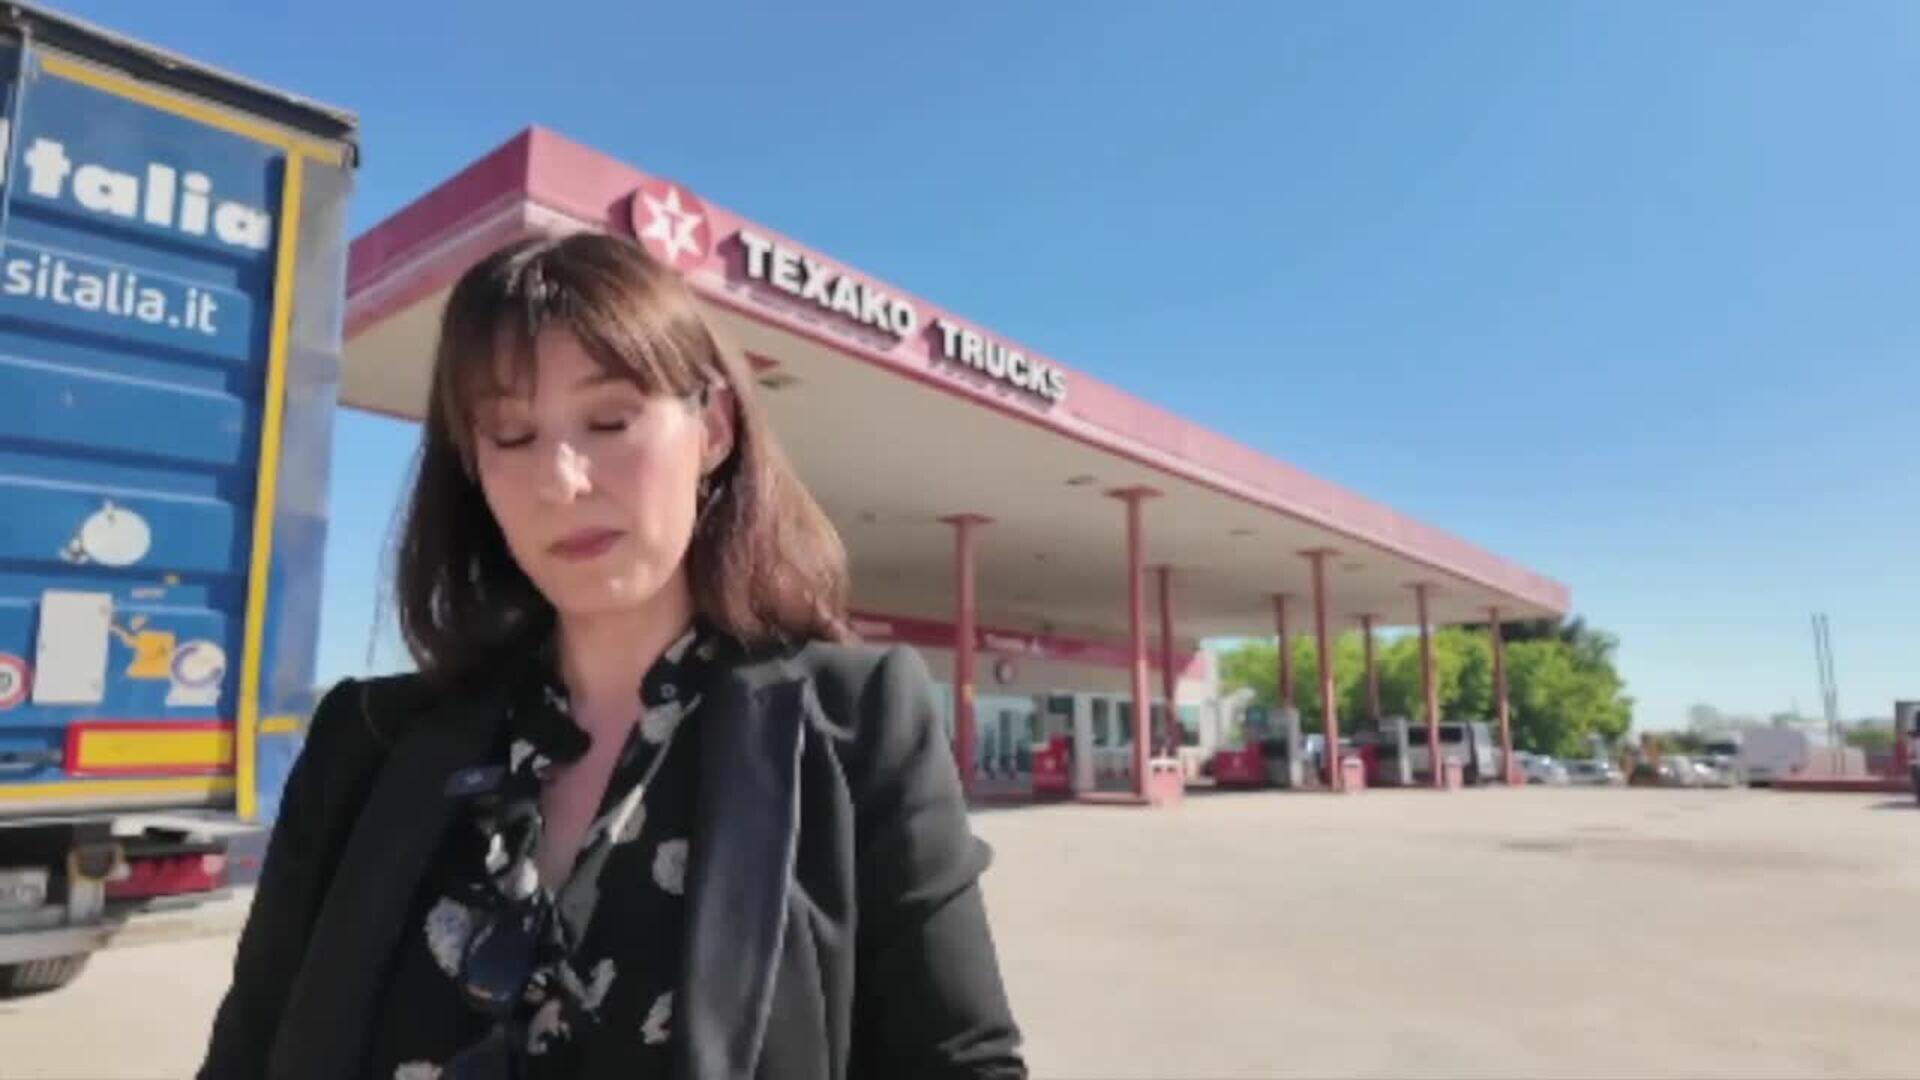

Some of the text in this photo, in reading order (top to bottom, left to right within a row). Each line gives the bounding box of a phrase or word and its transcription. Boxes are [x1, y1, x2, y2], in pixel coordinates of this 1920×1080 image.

[661, 209, 685, 240] T
[4, 255, 219, 334] sitalia.it
[739, 229, 1067, 401] TEXAKO TRUCKS
